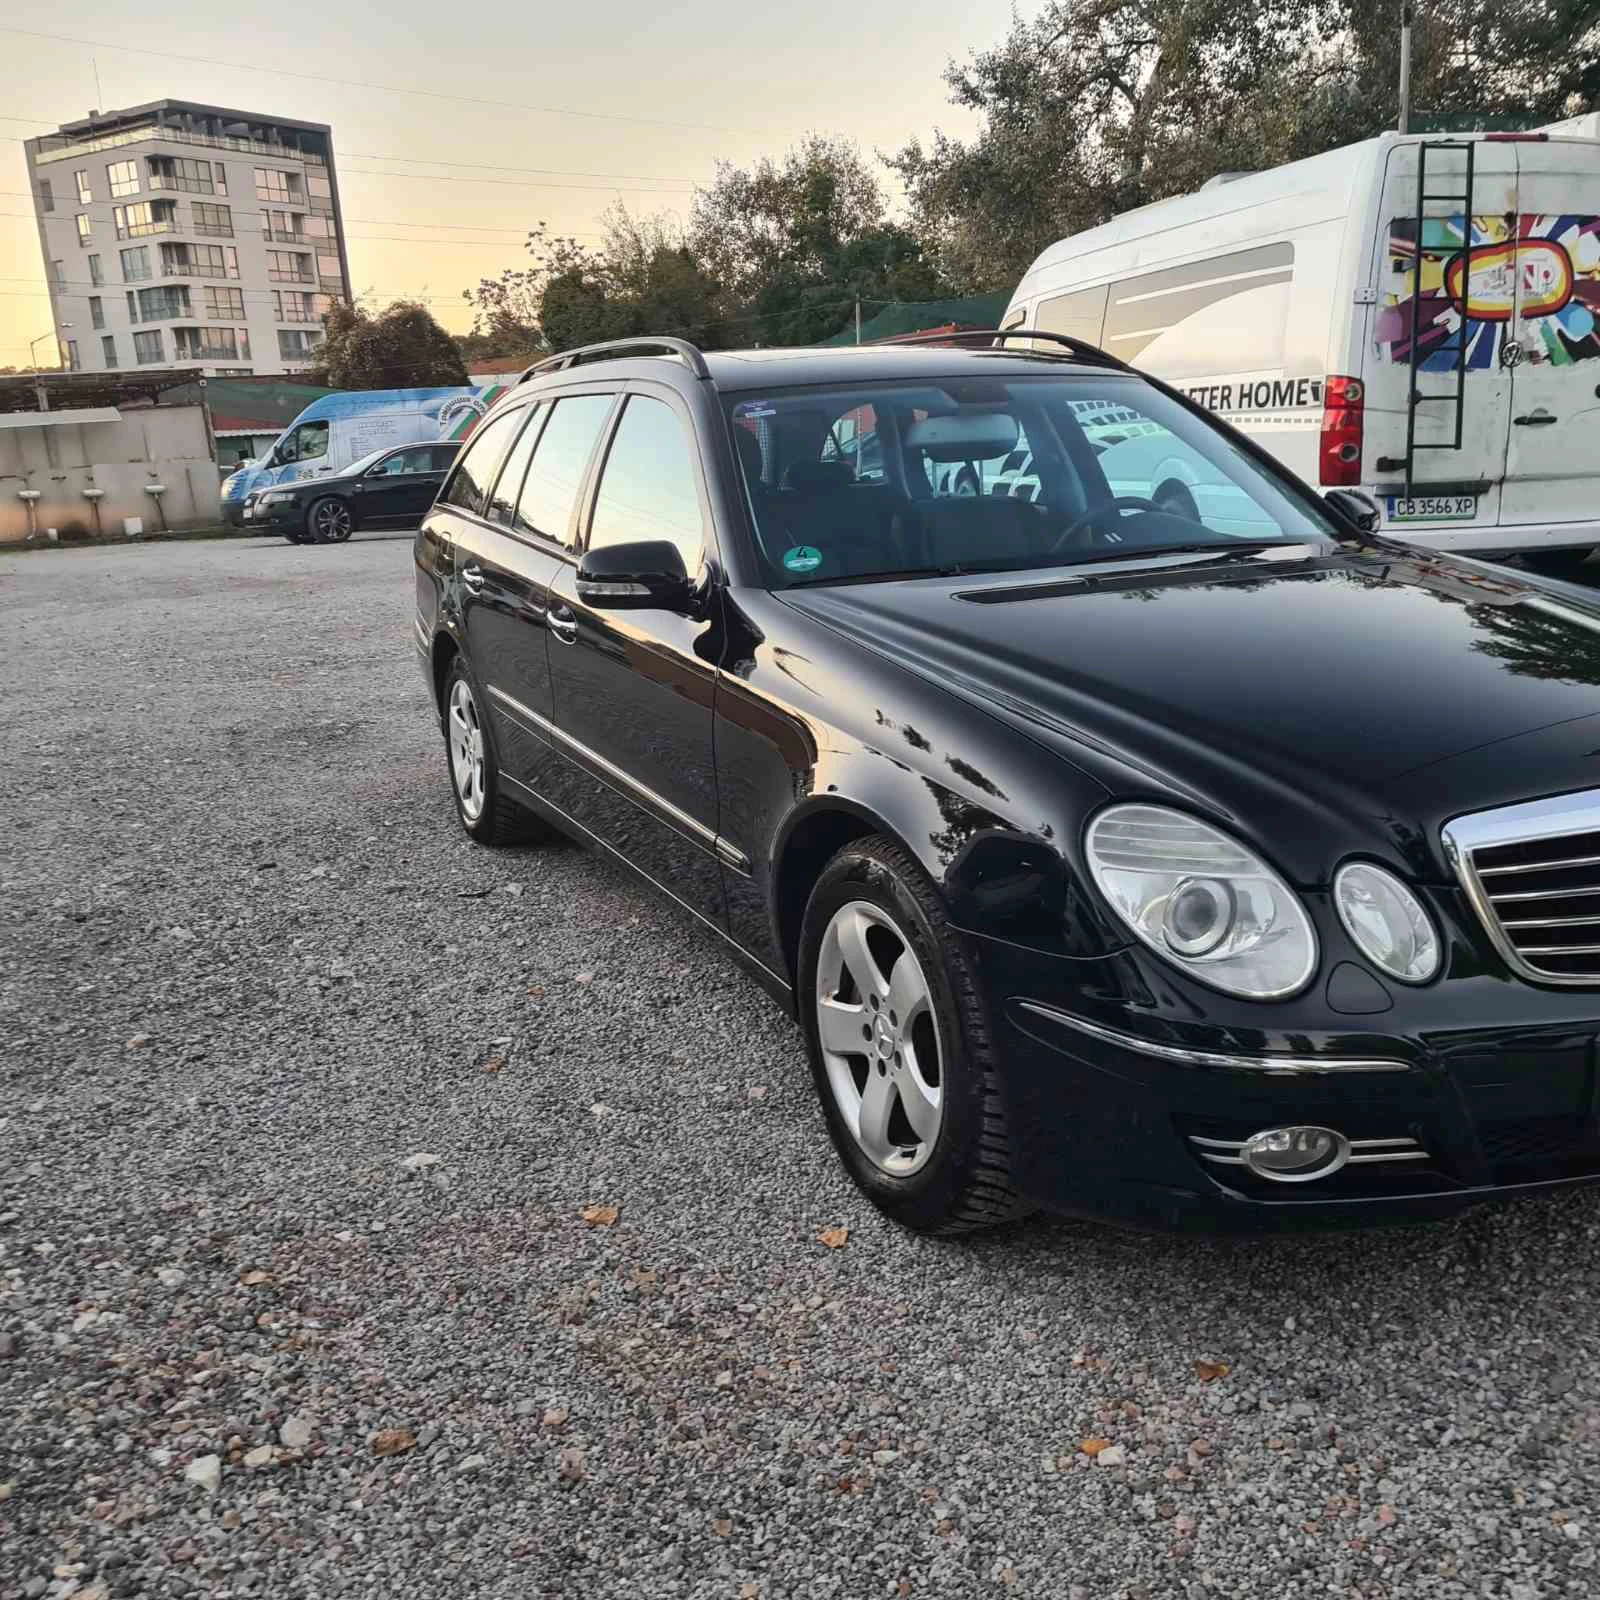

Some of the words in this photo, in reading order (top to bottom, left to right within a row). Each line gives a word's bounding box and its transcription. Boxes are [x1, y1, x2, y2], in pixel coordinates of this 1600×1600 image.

[1179, 384, 1232, 410] FTER
[1239, 378, 1310, 409] HOME
[1397, 500, 1416, 515] CB
[1419, 499, 1452, 514] 3566
[1455, 498, 1473, 513] XP
[796, 546, 808, 559] 4
